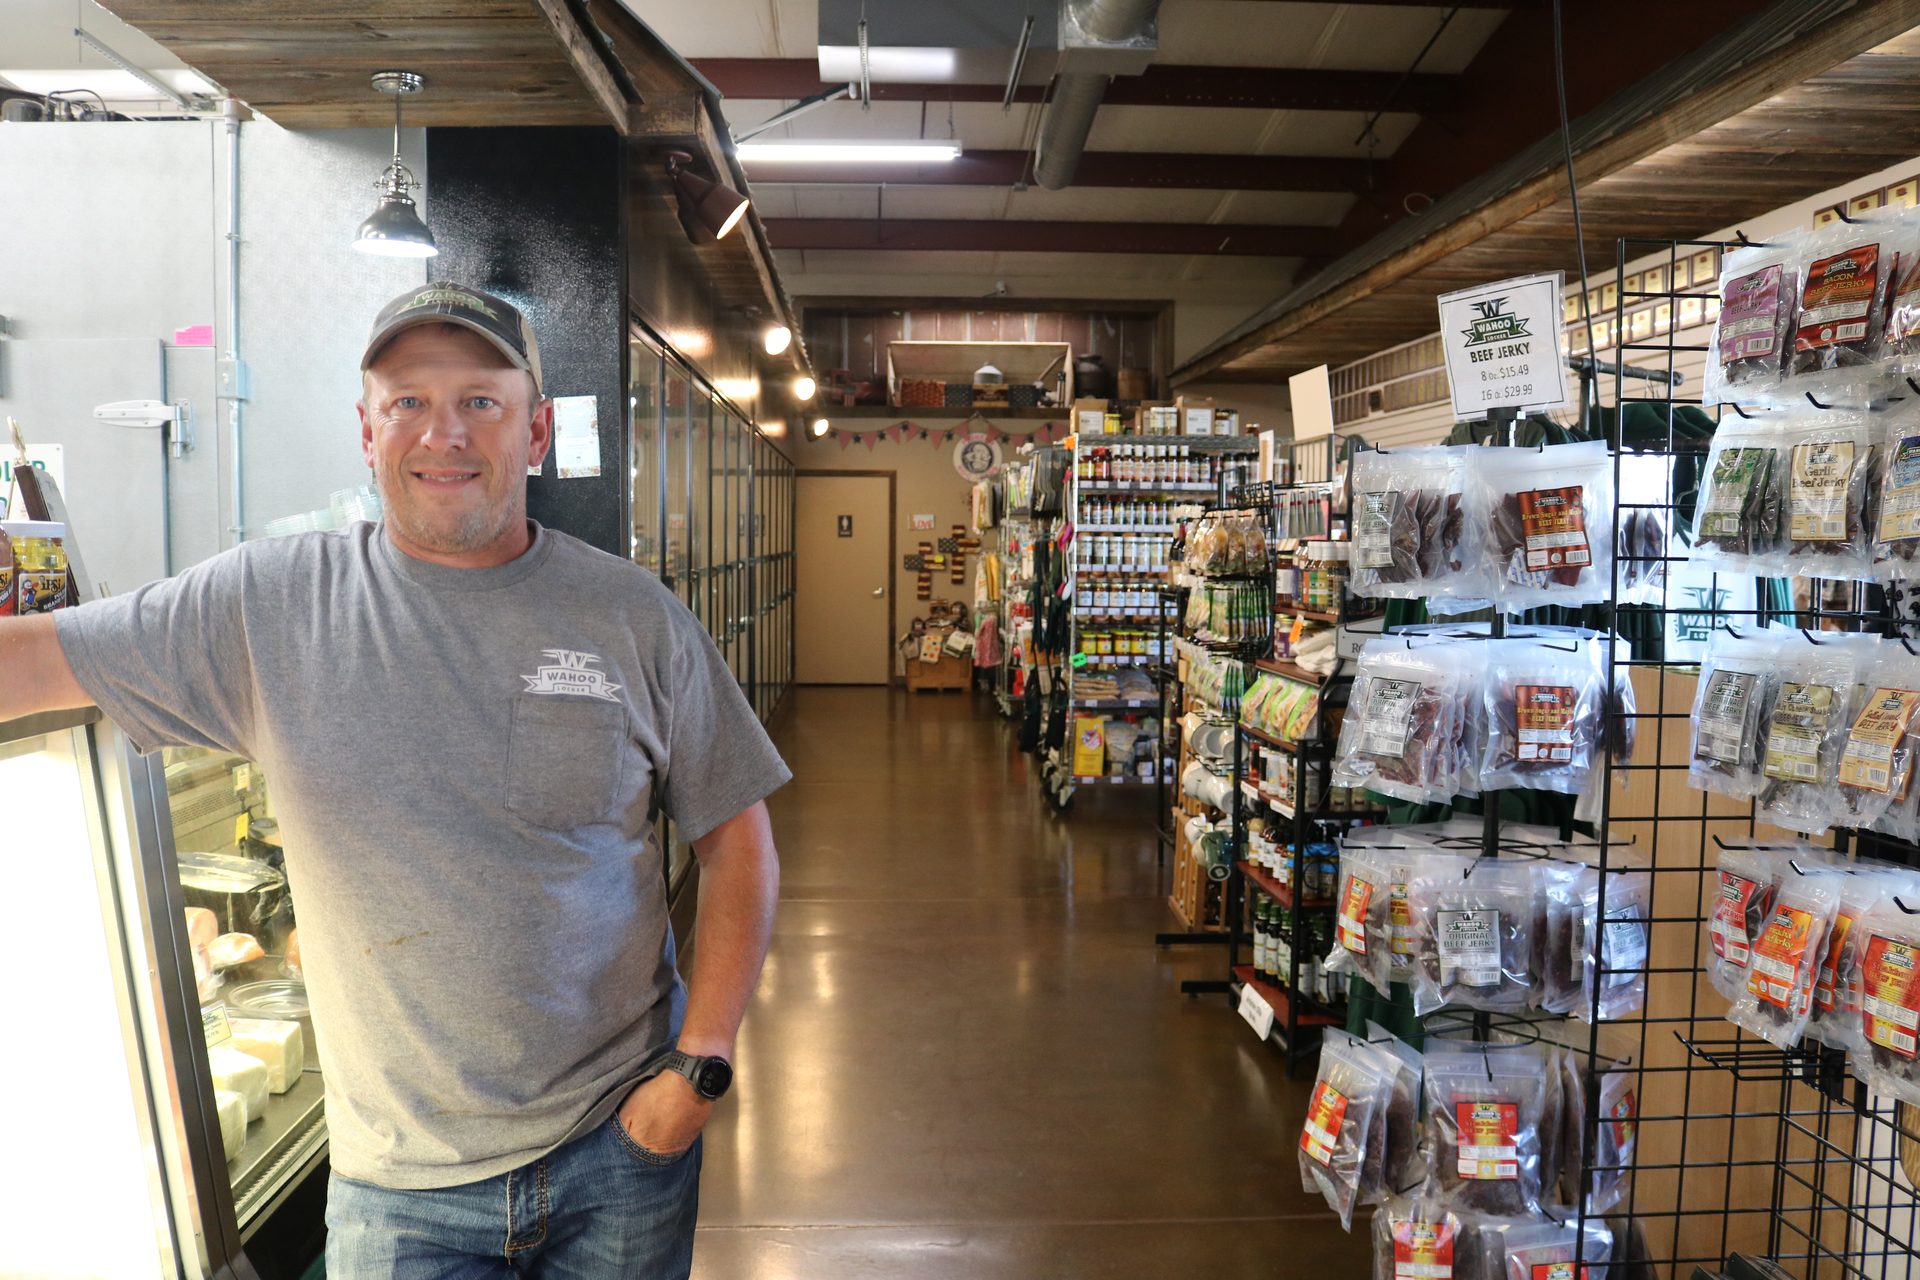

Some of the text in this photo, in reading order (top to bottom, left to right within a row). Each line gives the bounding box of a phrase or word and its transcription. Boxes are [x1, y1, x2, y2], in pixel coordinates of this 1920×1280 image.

[1834, 279, 1866, 290] JERKY
[1477, 319, 1511, 333] WAHOO
[1470, 342, 1530, 363] BEEF JERKY
[1481, 371, 1487, 381] 8
[1500, 364, 1529, 379] $15.49
[1482, 391, 1492, 401] 16
[1504, 384, 1533, 398] $29.99
[1805, 466, 1837, 477] Garlic
[1792, 477, 1847, 489] Beef Jerky
[547, 671, 597, 684] WAHOO
[1448, 932, 1489, 940] ORIGINAL
[1443, 940, 1496, 948] BEEF JERKY
